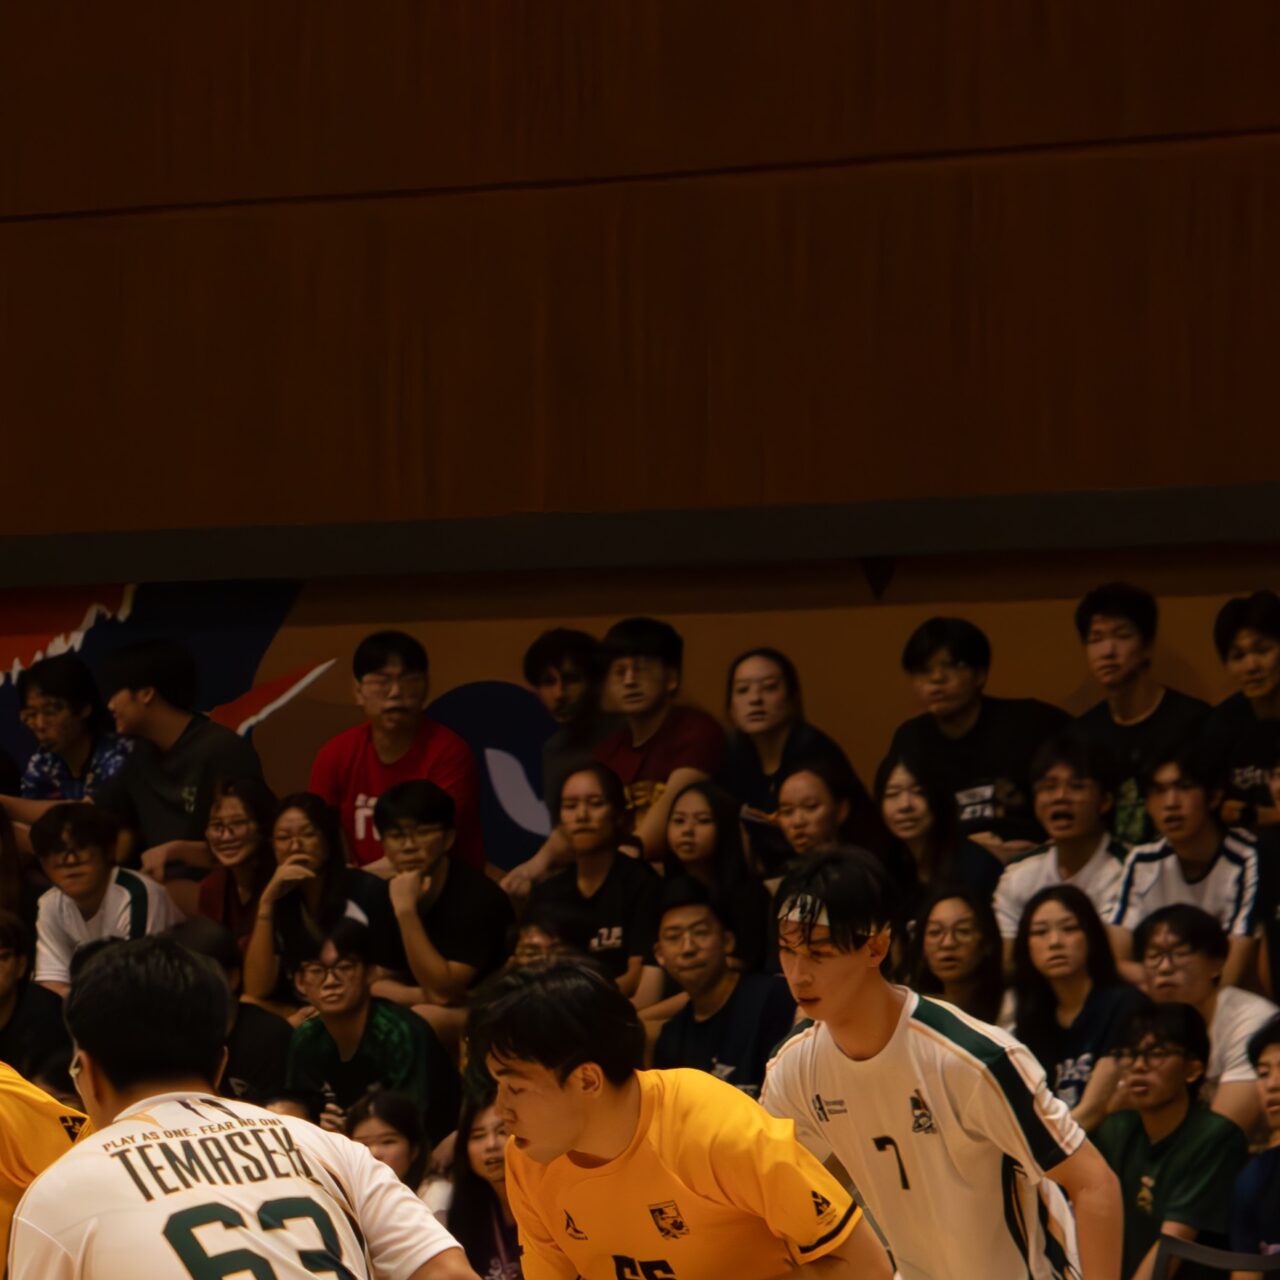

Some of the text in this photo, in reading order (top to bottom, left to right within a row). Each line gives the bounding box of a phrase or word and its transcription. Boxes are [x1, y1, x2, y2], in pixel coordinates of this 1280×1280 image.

[102, 1133, 137, 1152] PLAY
[141, 1130, 161, 1143] AS
[200, 1122, 236, 1136] FEAR
[239, 1117, 257, 1128] NO
[109, 1127, 315, 1202] TEMASEK
[872, 1135, 911, 1191] 7
